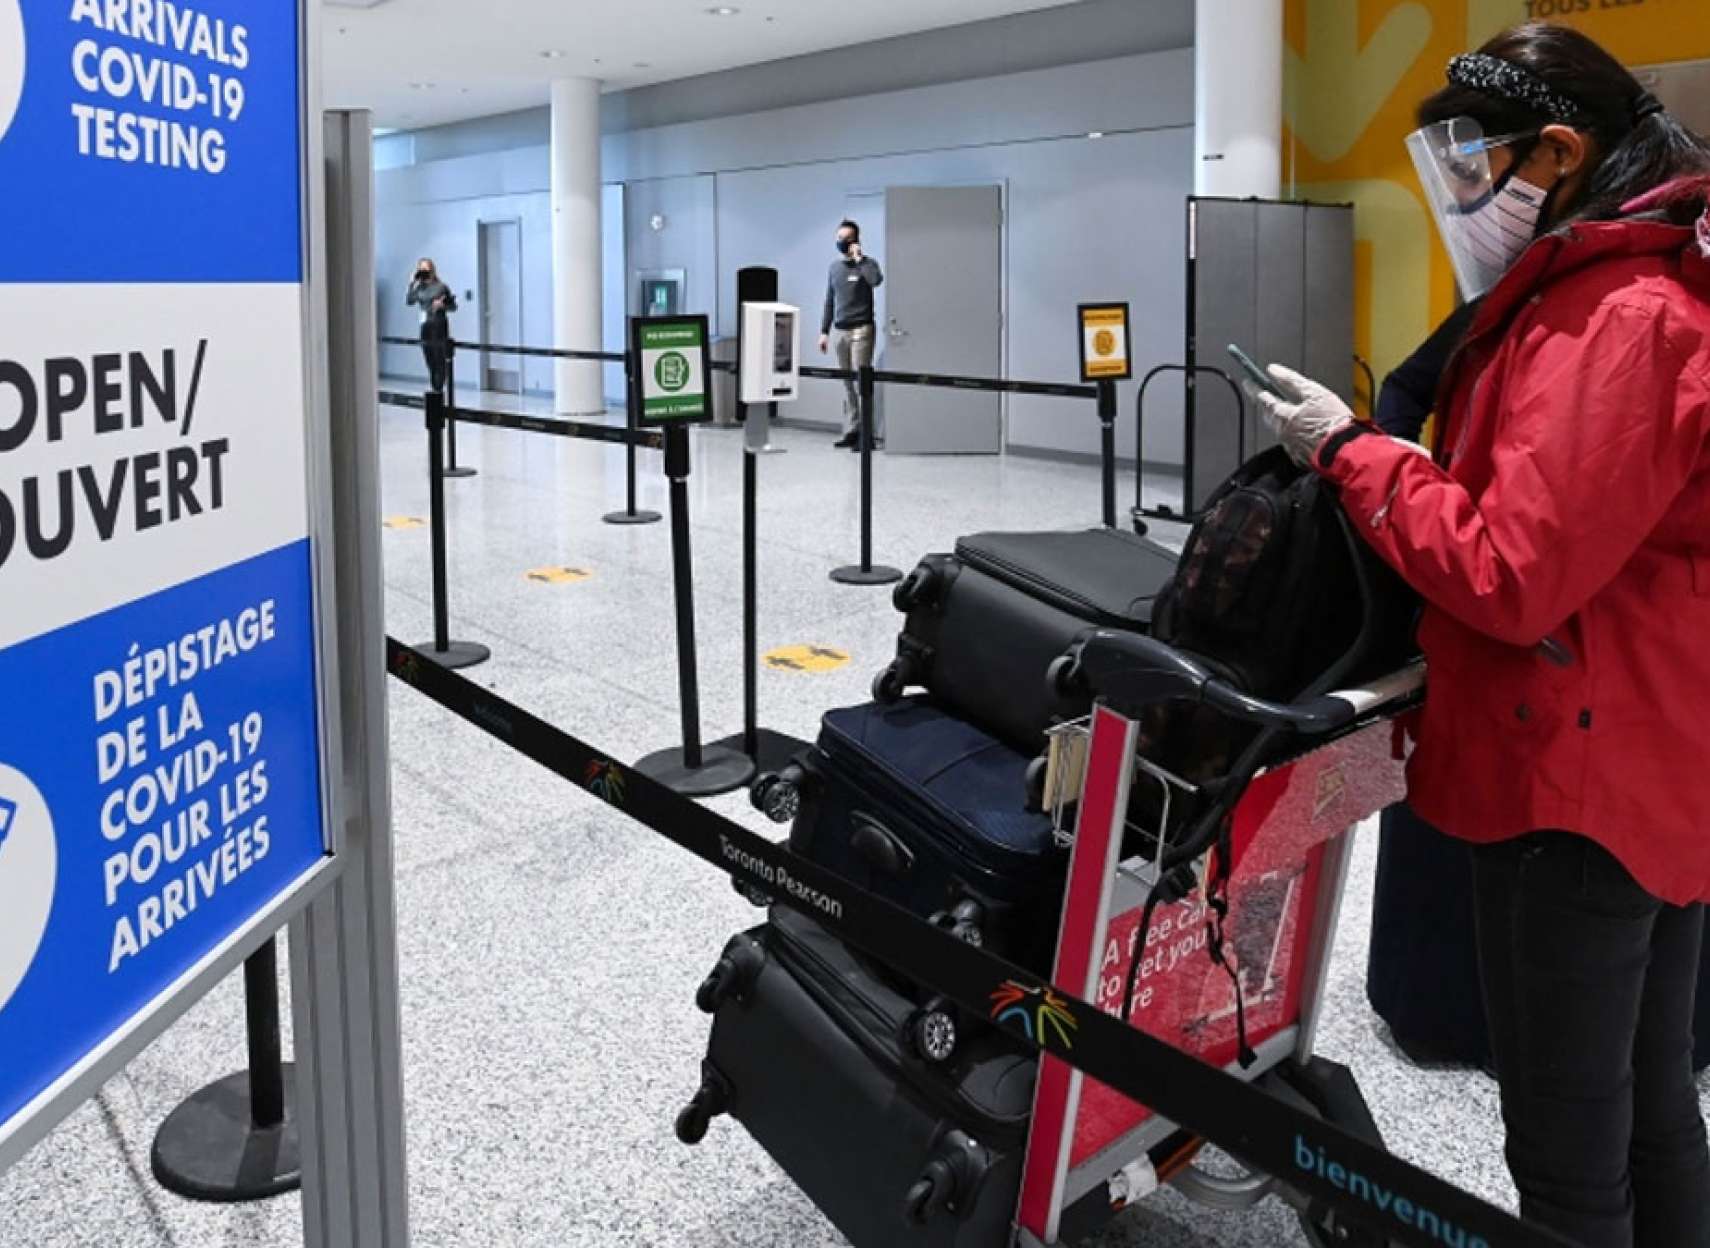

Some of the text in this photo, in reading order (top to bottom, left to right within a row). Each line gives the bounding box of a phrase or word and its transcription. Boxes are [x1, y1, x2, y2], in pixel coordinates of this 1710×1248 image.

[72, 39, 244, 121] COVID-19
[71, 103, 226, 174] TESTING
[0, 438, 229, 568] UVERT
[93, 599, 275, 722] DÉPISTAGE
[97, 690, 204, 784] DE LA
[100, 711, 263, 842] COVID-19
[104, 760, 269, 906] POUR LES
[719, 833, 843, 918] Toronto Pearson
[108, 815, 271, 974] ARRIVÉES
[1098, 974, 1121, 1003] to
[1102, 938, 1119, 967] A
[1128, 917, 1173, 957] fee
